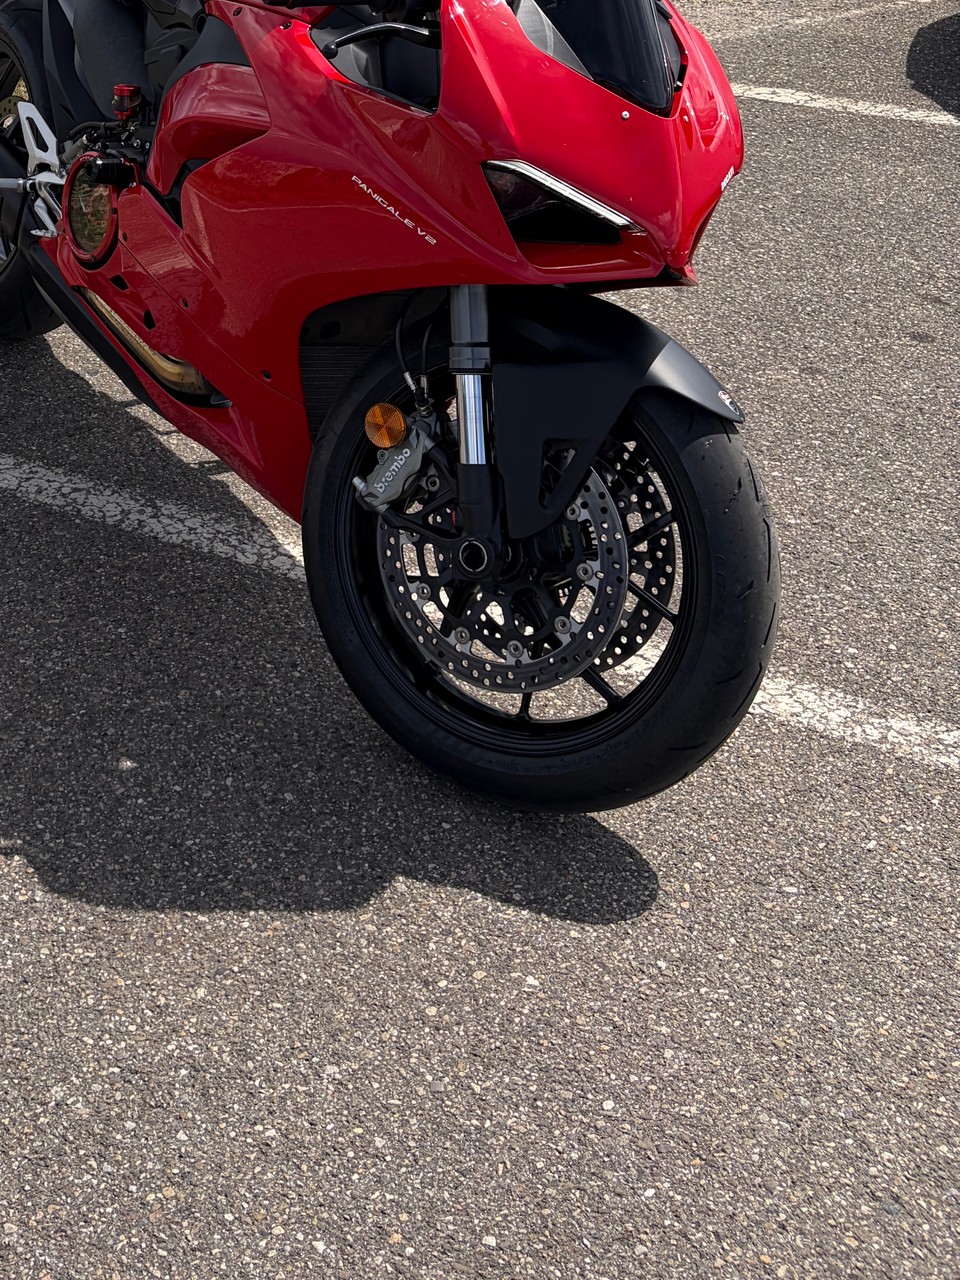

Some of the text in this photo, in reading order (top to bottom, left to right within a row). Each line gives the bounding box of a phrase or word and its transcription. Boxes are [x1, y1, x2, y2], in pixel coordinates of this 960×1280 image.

[351, 174, 437, 246] PANIGALE V2
[374, 447, 411, 494] brembo
